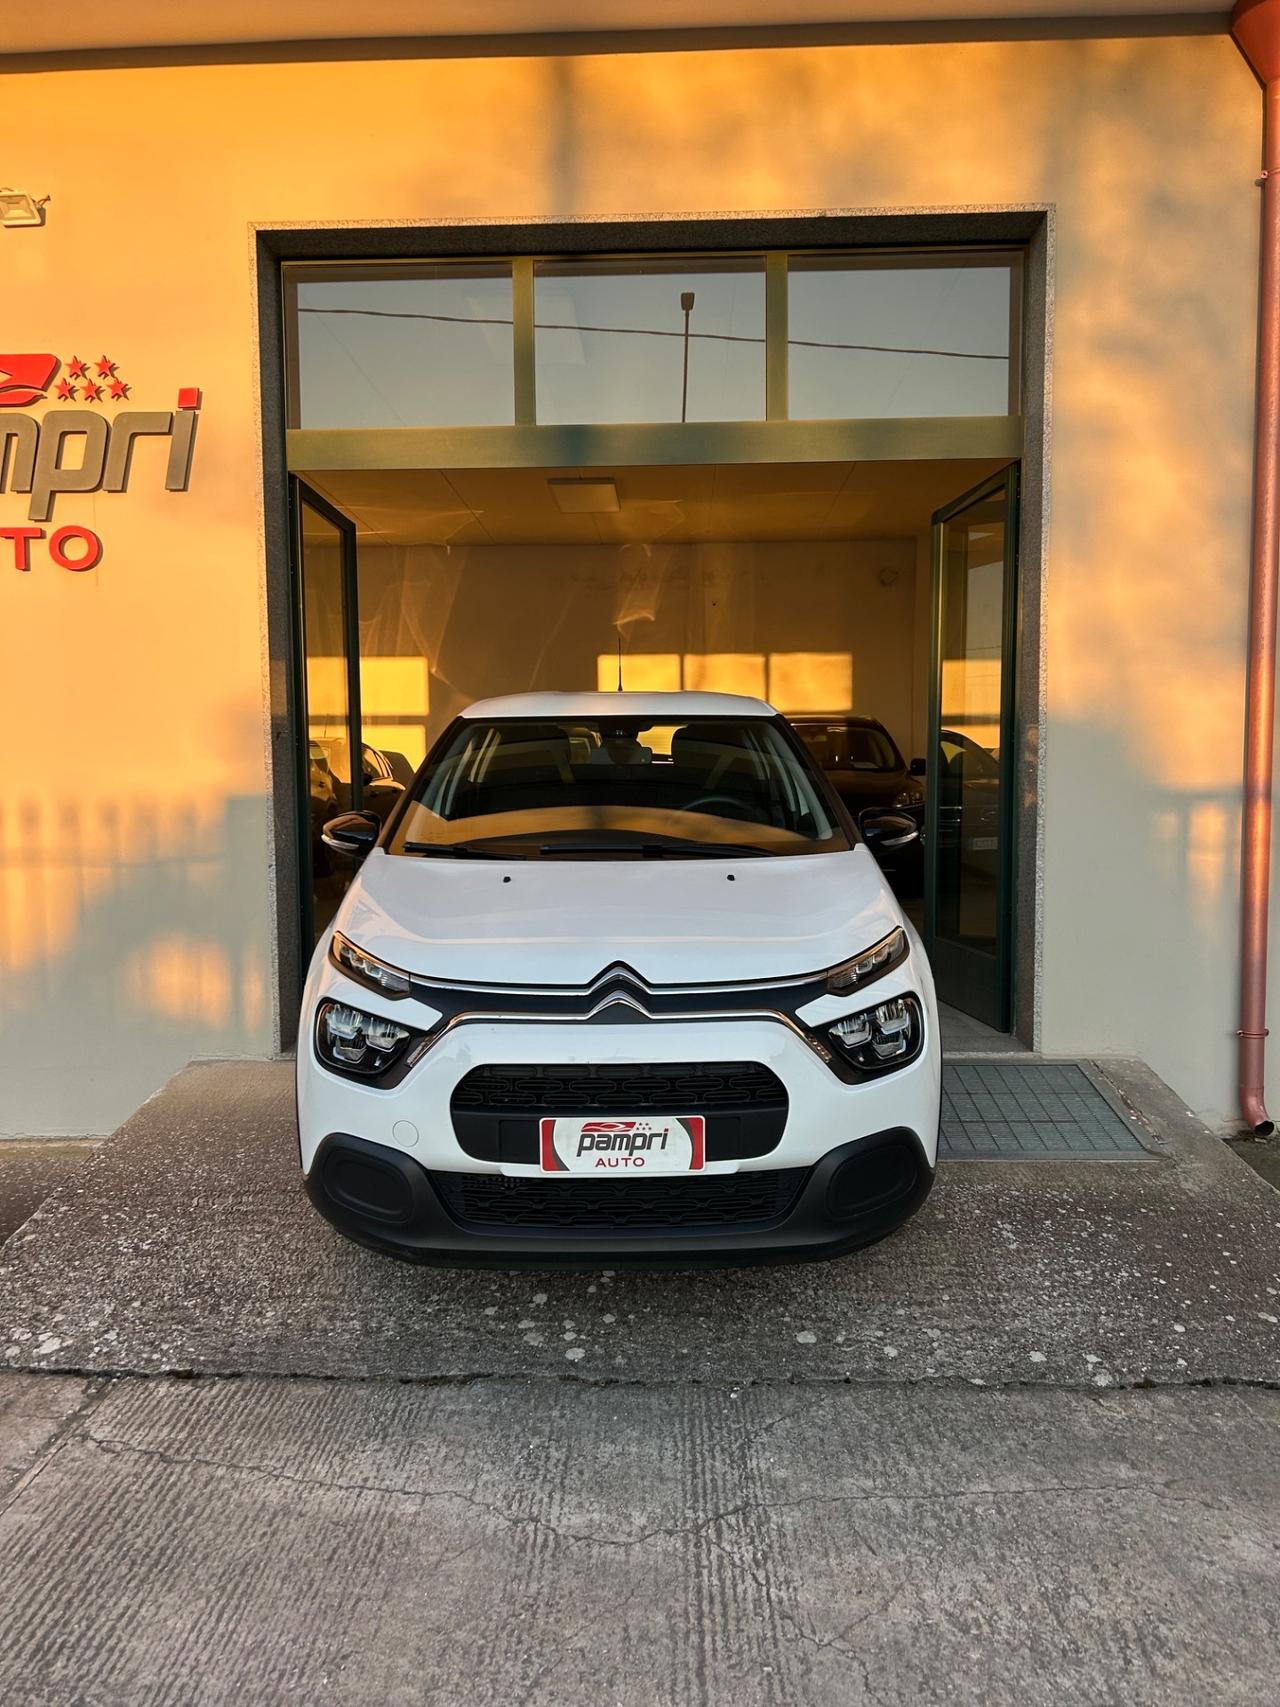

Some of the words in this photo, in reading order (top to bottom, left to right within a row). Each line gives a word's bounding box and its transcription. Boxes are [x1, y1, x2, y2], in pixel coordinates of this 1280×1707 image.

[0, 525, 100, 571] TO
[576, 1128, 669, 1157] pampri
[595, 1157, 645, 1168] AUTO
